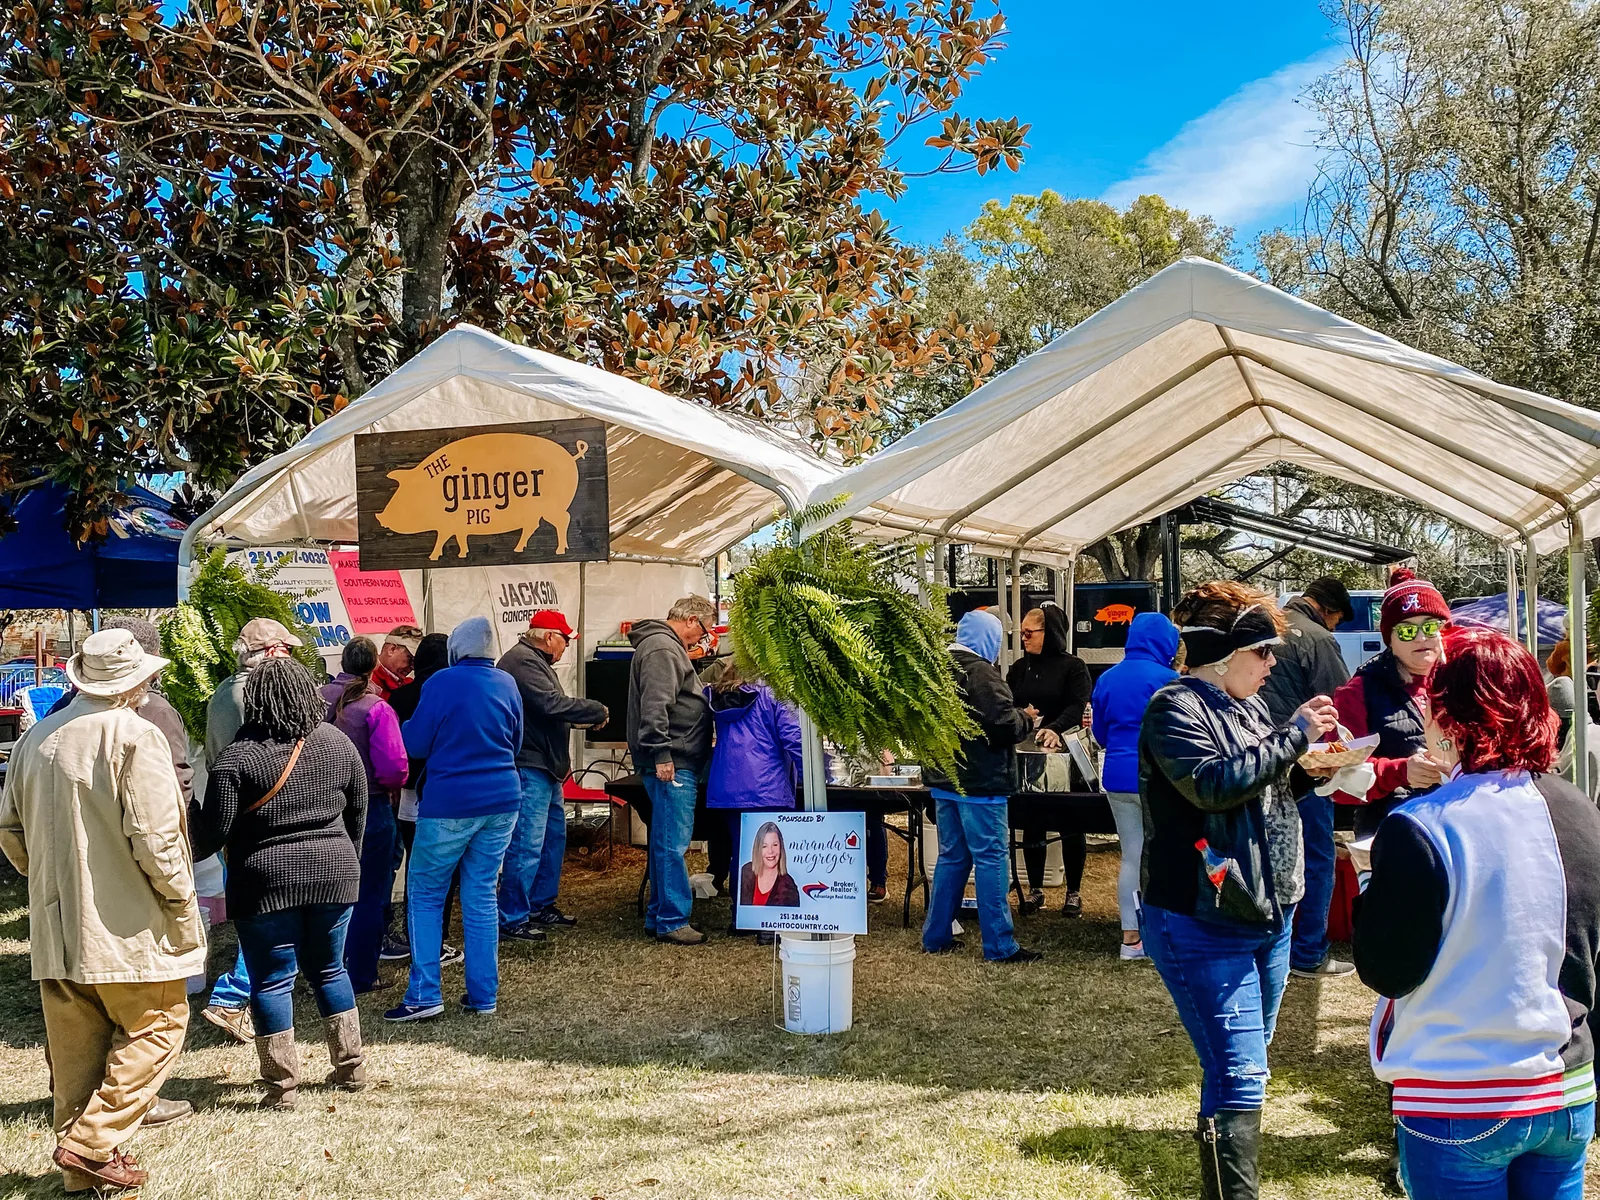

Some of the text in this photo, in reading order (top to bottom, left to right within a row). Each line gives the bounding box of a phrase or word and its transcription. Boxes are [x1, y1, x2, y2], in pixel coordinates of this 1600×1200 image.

[423, 454, 451, 479] THE
[442, 466, 544, 512] ginger
[466, 508, 491, 525] PIG
[343, 578, 402, 588] SOUTHERN ROOTS
[347, 597, 364, 606] FULL
[364, 597, 388, 606] SERVICE
[499, 581, 559, 607] JACKSON
[1402, 592, 1421, 611] A
[502, 608, 541, 624] CONCRET
[1106, 610, 1129, 618] ginger
[777, 814, 826, 823] SPONSORED BY
[788, 833, 844, 851] miranda
[792, 851, 856, 874] mcgregor
[760, 921, 840, 931] BEACHTOCOUNTRY.COM
